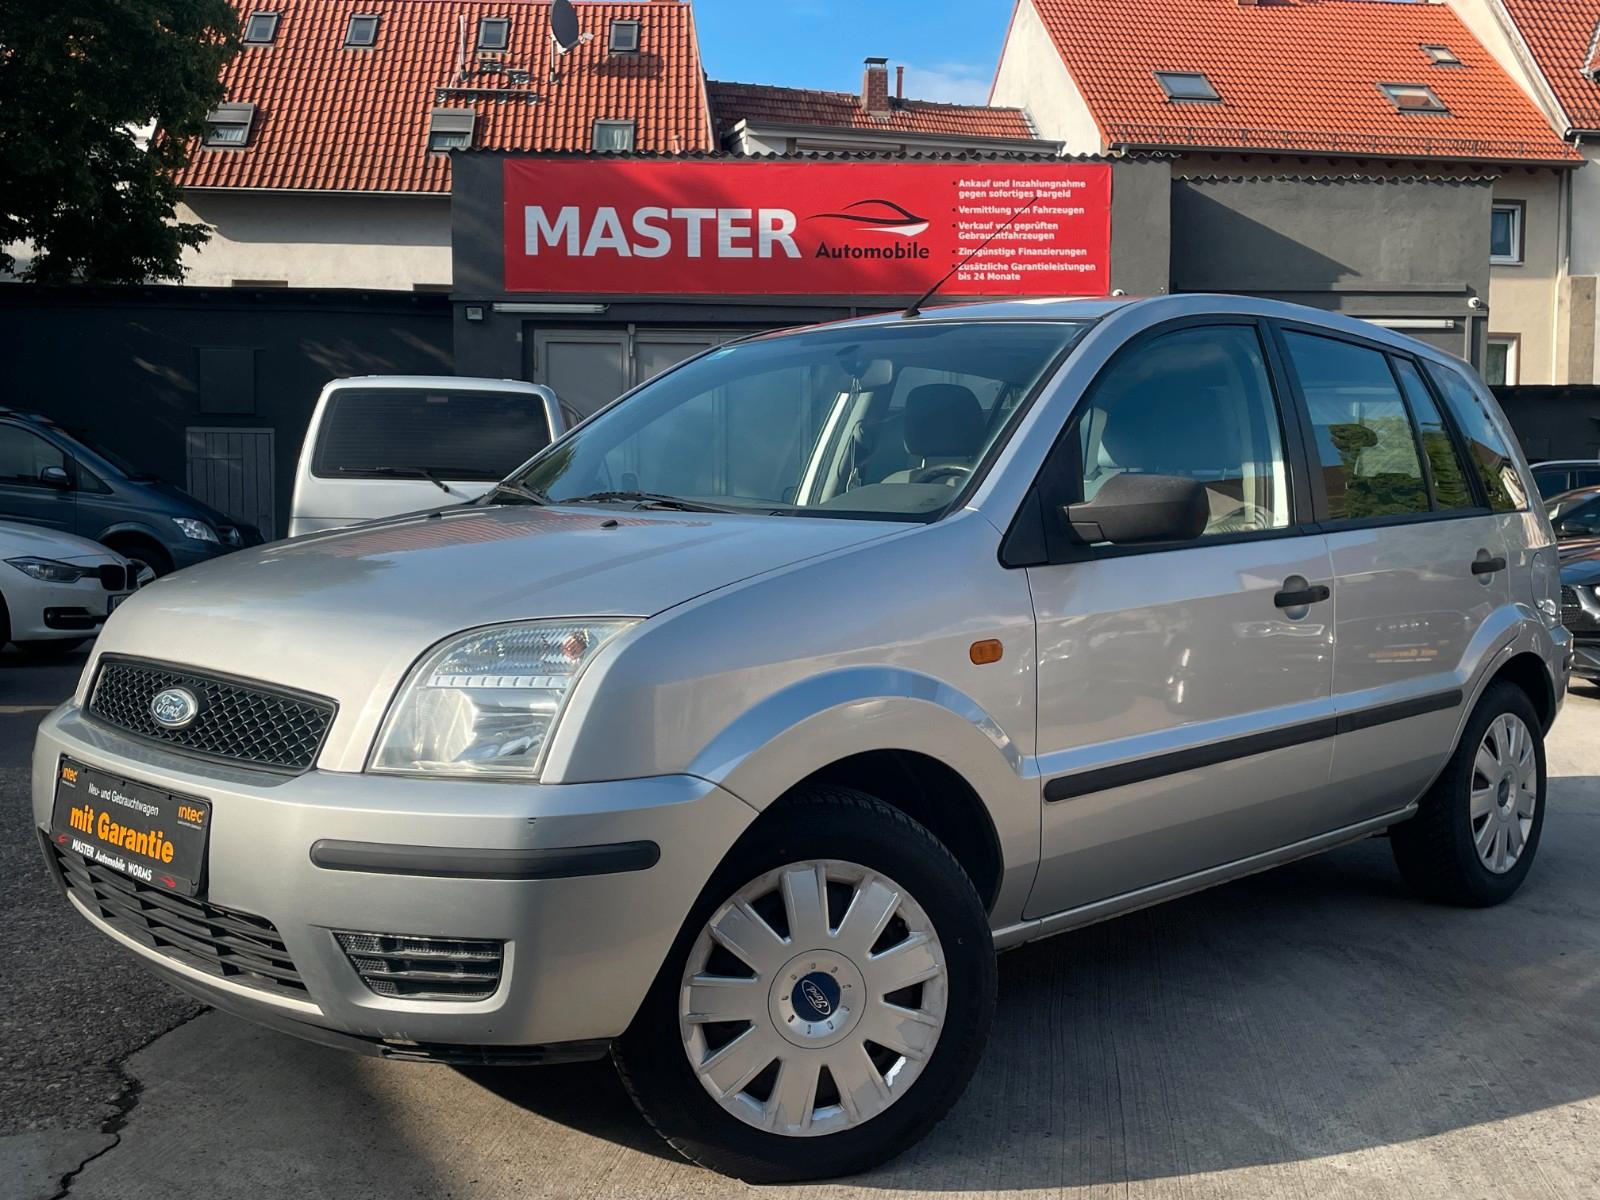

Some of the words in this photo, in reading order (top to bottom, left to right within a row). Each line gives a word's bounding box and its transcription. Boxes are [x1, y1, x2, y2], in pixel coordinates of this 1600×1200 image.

[959, 180, 991, 188] Ankauf
[993, 180, 1010, 188] und
[1013, 180, 1086, 189] Inzahlungnahme
[959, 191, 986, 199] gegen
[989, 190, 1034, 199] sofortiges
[1036, 190, 1071, 199] Bargeld
[959, 206, 1011, 215] Vermittlung
[1033, 206, 1084, 215] Fahrzeugen
[1015, 222, 1058, 231] geprüften
[524, 205, 802, 259] MASTER
[815, 241, 930, 260] Automobile
[1018, 248, 1087, 257] Finanzierungen
[1011, 263, 1095, 272] Garantieleistungen
[987, 273, 1020, 281] Monate
[156, 694, 184, 718] Ford
[88, 782, 100, 795] Neu-
[101, 788, 111, 800] und
[111, 791, 159, 816] Gebrauchtwagen
[70, 805, 94, 834] mit
[97, 812, 174, 863] Garantie
[72, 839, 95, 857] MASTER
[95, 850, 126, 872] Automobile
[128, 862, 152, 881] WORMS
